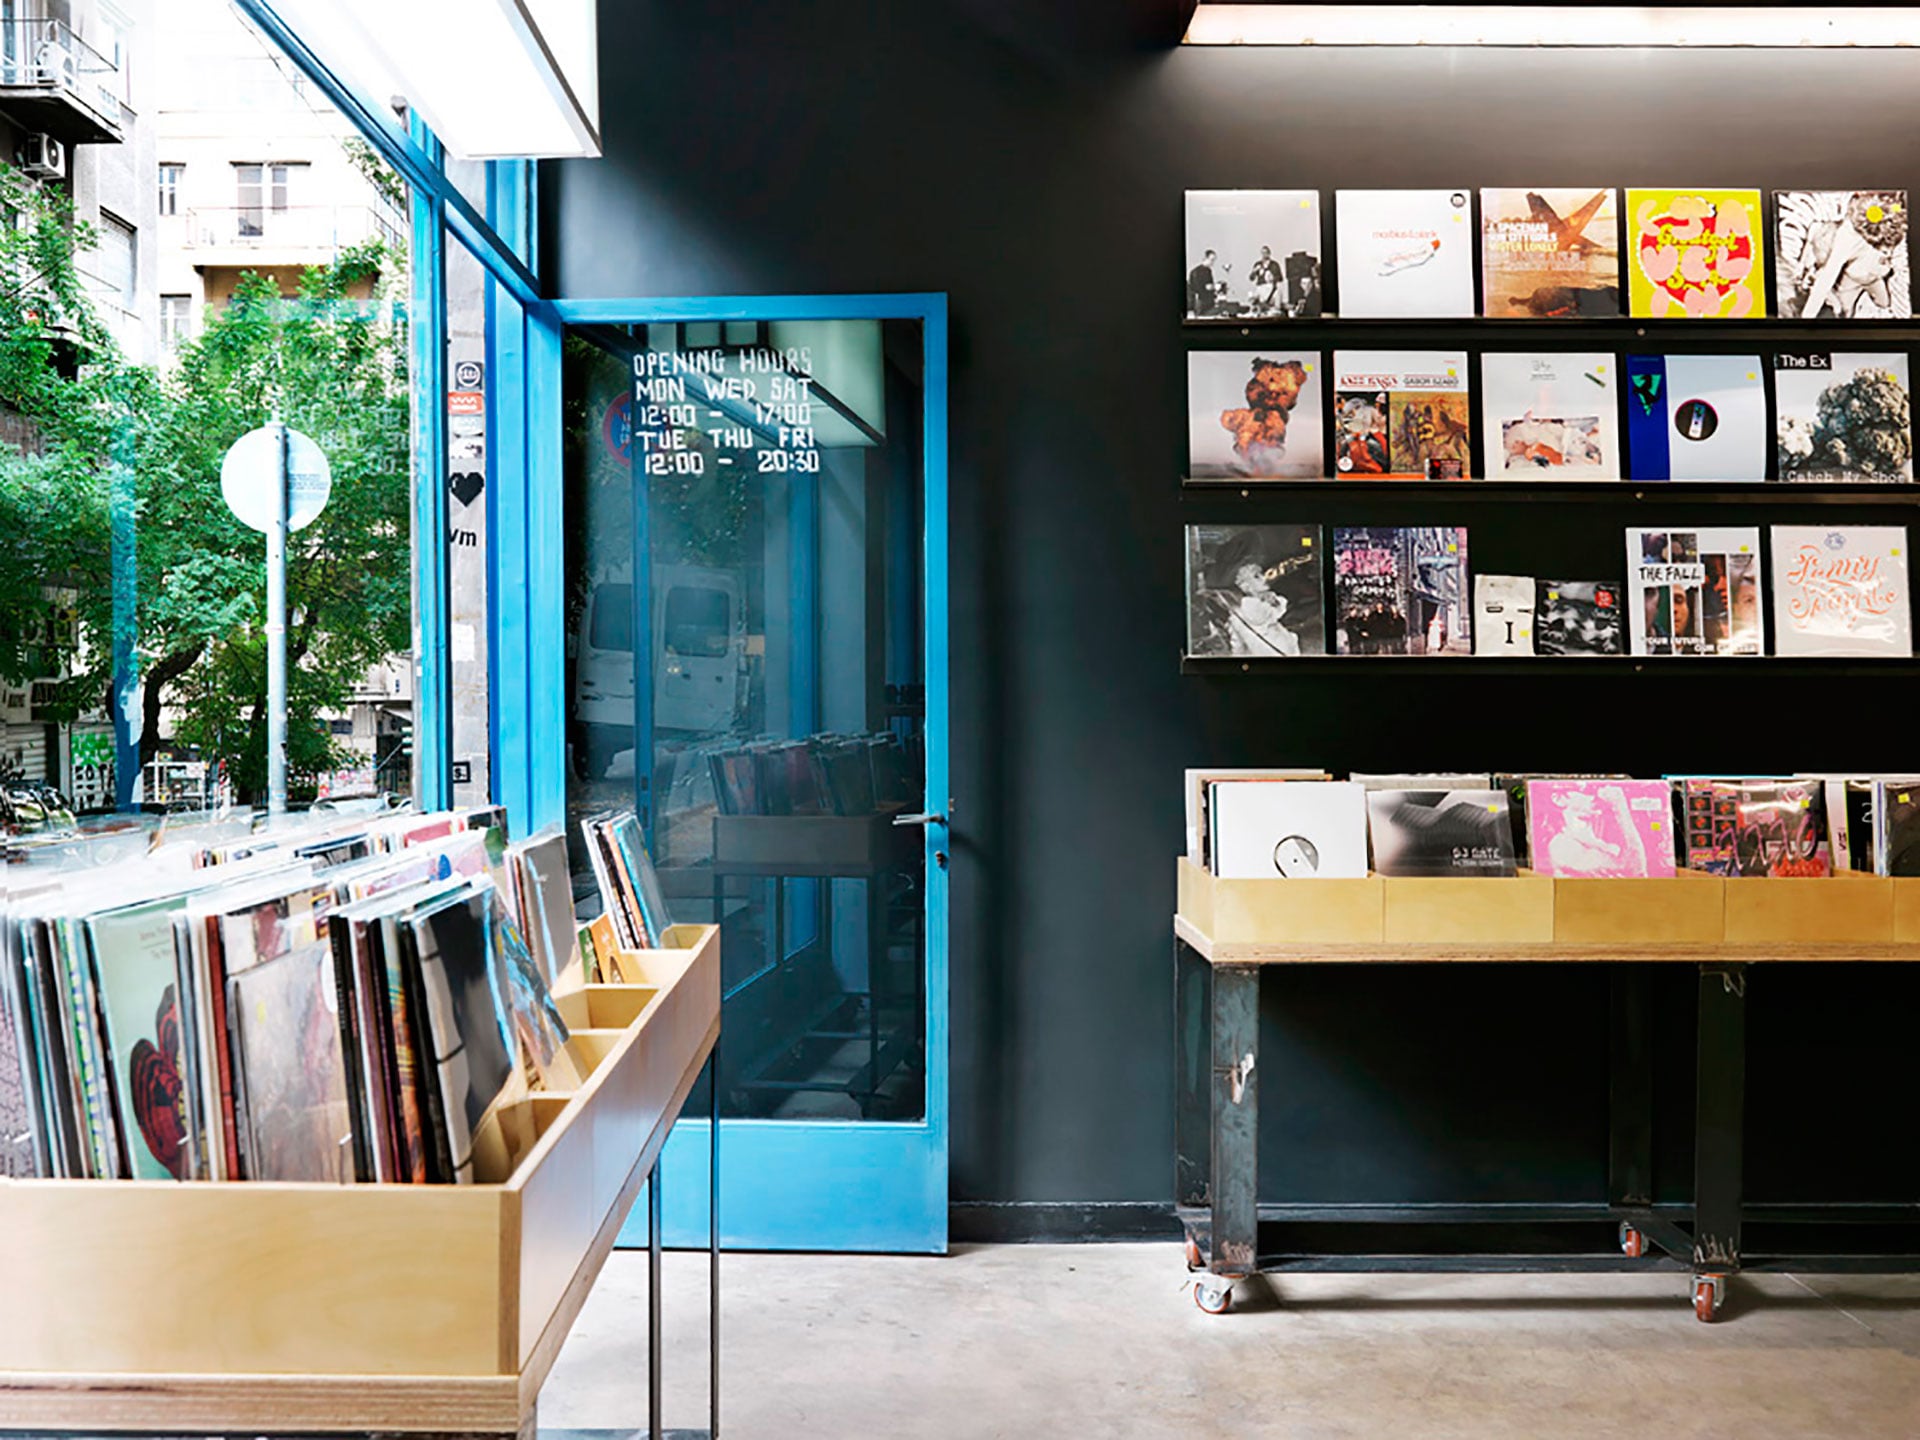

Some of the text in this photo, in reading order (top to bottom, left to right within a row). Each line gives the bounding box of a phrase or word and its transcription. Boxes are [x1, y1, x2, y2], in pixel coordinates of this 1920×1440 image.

[633, 347, 812, 376] OPENING HOURS
[1780, 355, 1828, 367] The Ex
[636, 377, 813, 402] MON WED SAT
[641, 404, 696, 427] 12:00
[756, 402, 811, 425] 17:00
[635, 428, 815, 452] TUE THU FRI
[645, 452, 704, 475] 12:00
[758, 449, 820, 472] 20:30
[1787, 471, 1905, 483] Catch My Shoe
[1638, 565, 1701, 582] THE FALL
